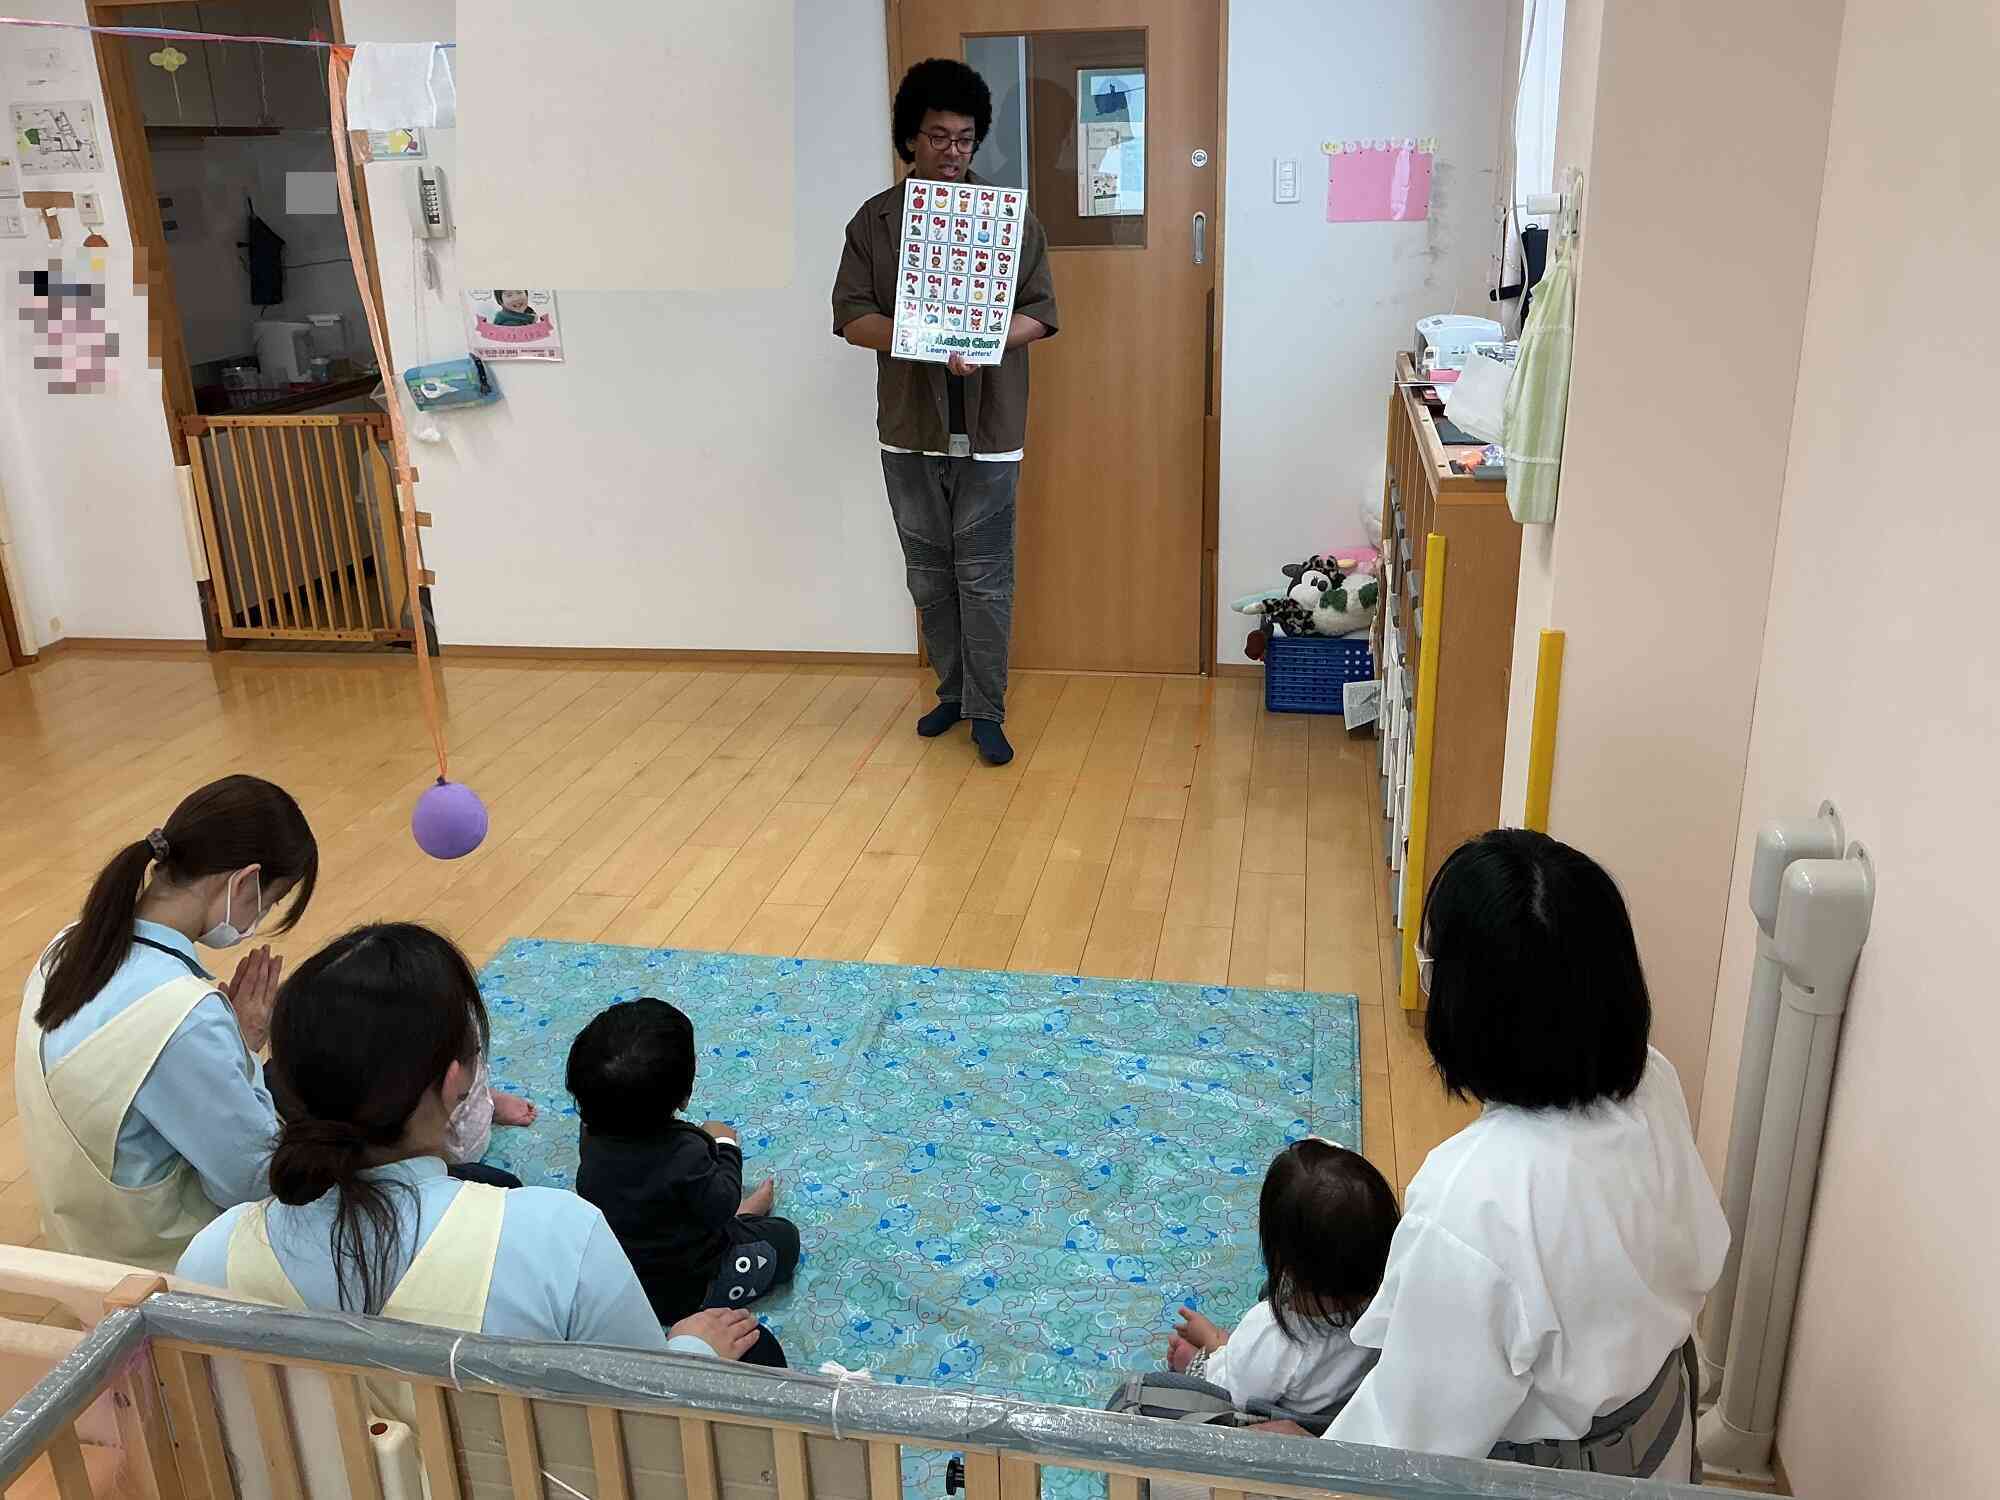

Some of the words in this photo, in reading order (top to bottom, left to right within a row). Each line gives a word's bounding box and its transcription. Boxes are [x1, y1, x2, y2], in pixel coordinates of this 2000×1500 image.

[913, 186, 926, 195] Aa
[936, 188, 948, 197] Bb
[959, 190, 970, 199] Cc
[981, 192, 994, 201] Dd
[933, 217, 945, 228] Gg
[955, 219, 968, 228] Hh
[952, 248, 967, 257] Mm
[976, 250, 988, 260] Nn
[998, 252, 1010, 262] Oo
[906, 272, 918, 284] Pp
[952, 277, 962, 286] Rr
[974, 279, 984, 288] Ss
[996, 281, 1007, 290] Tt
[926, 303, 939, 313] Vv
[947, 306, 962, 315] Ww
[992, 309, 1003, 319] Yy
[971, 337, 1000, 349] Chart
[926, 345, 947, 354] Learn
[967, 349, 992, 357] Letters!
